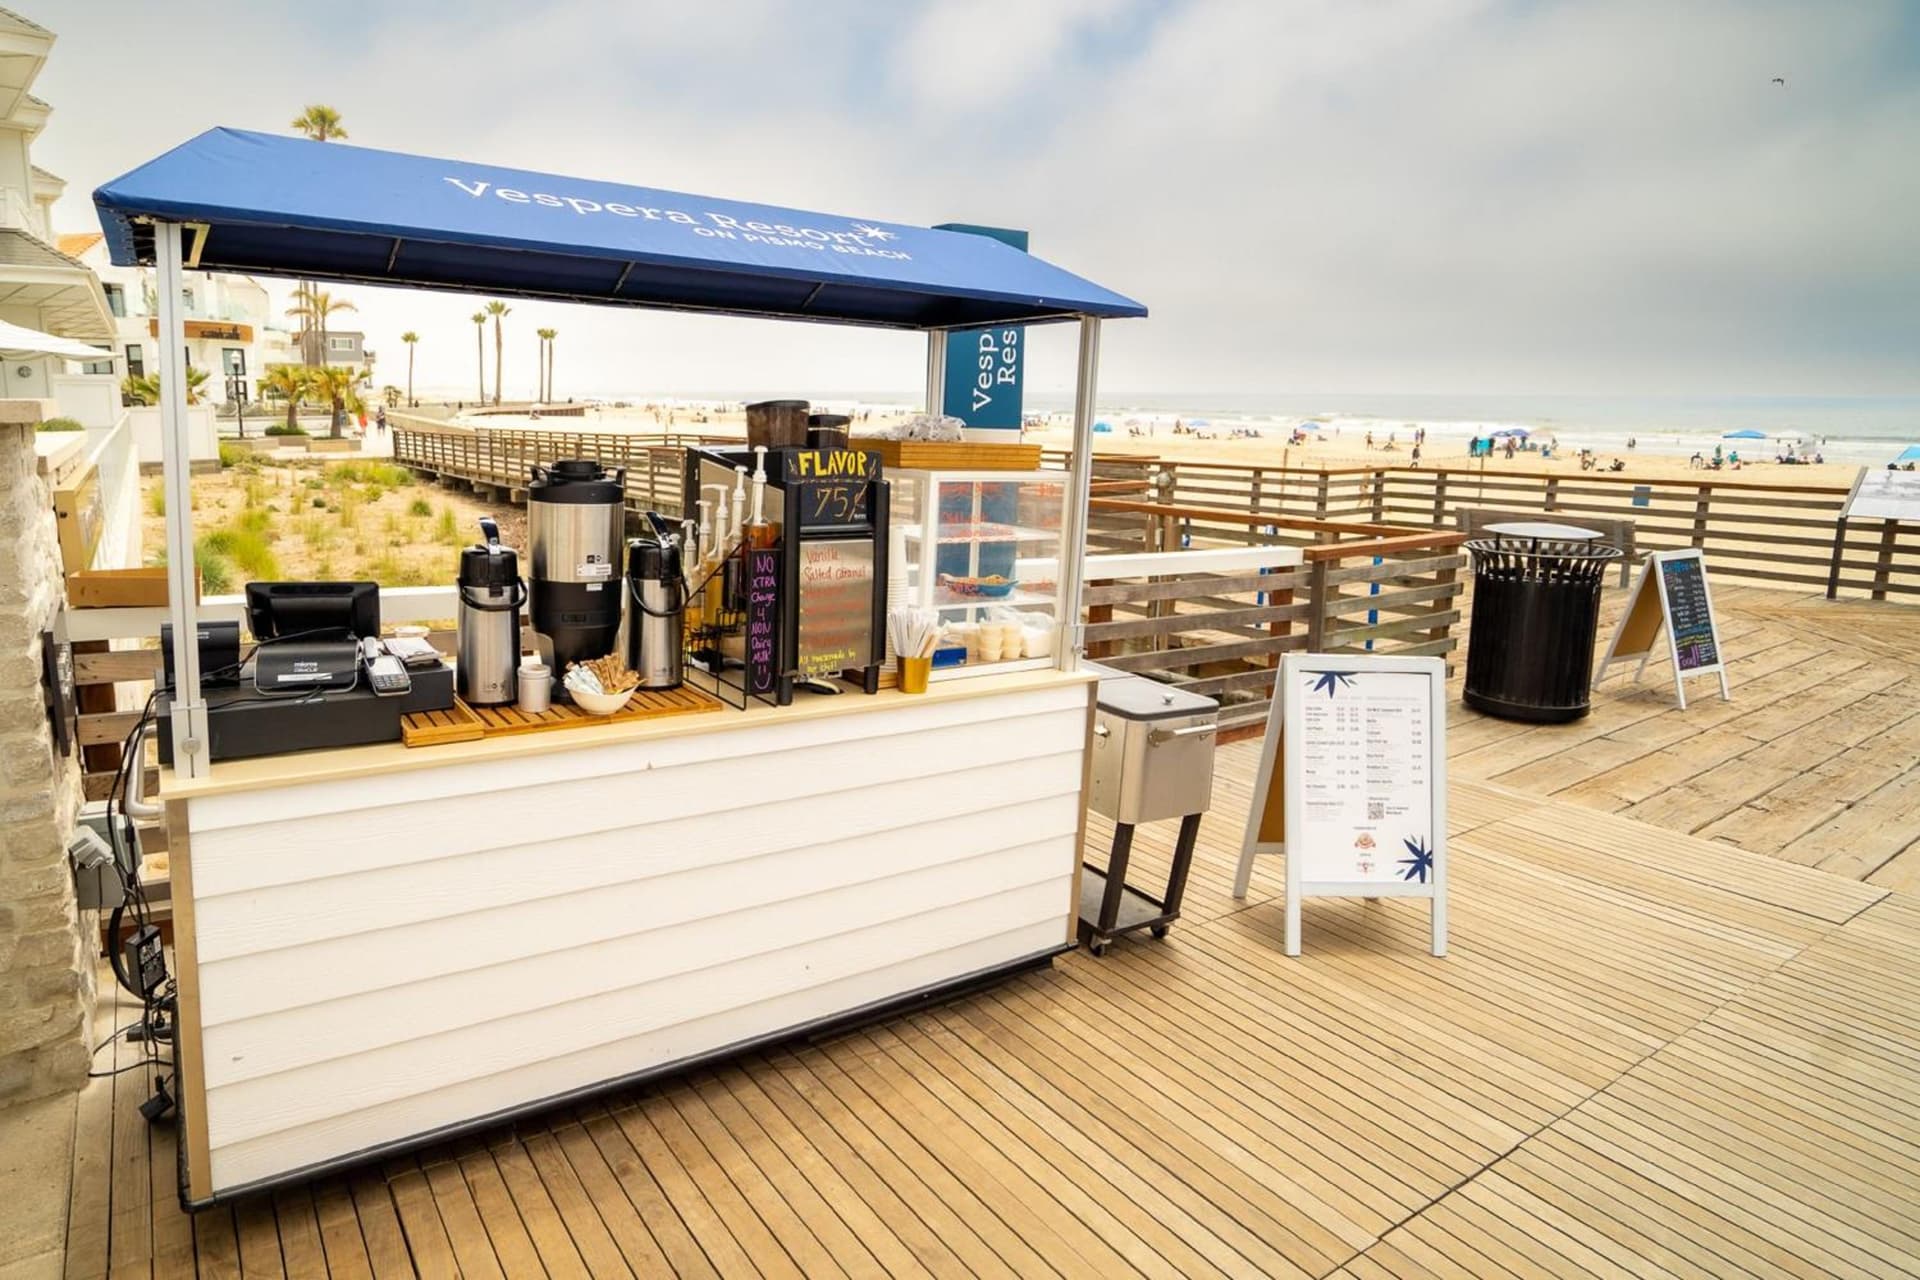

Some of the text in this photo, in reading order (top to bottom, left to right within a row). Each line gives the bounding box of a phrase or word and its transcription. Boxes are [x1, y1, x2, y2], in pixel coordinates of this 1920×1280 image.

[443, 175, 874, 248] Vespera Resort
[693, 226, 914, 262] ON PISMO BEACH
[972, 328, 999, 412] Vesp
[798, 450, 867, 477] FLAVOR
[756, 555, 774, 574] NO
[752, 575, 776, 589] XTRA
[756, 607, 765, 621] 4
[751, 621, 772, 635] NON
